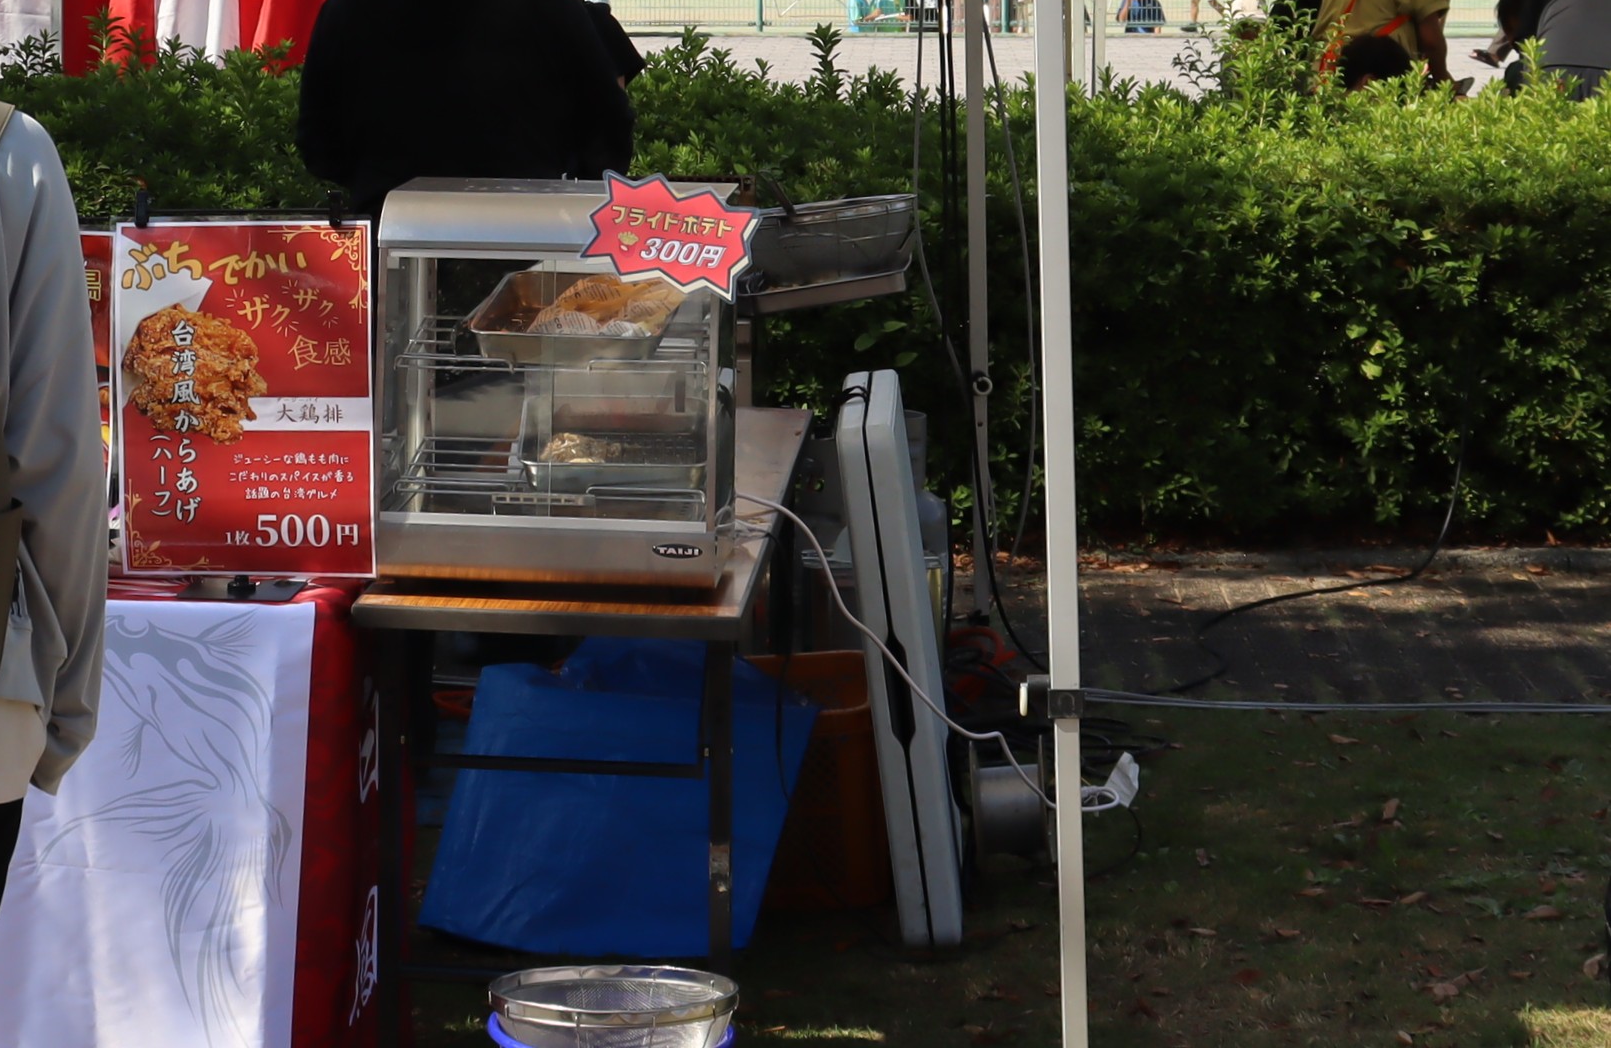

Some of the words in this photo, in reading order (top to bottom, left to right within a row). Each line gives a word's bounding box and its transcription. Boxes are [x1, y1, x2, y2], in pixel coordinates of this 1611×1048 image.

[640, 237, 727, 268] 300円
[288, 334, 351, 370] 食感
[170, 319, 202, 525] 台湾風からあげ
[276, 403, 344, 424] 大鶏排
[233, 453, 350, 466] ジューシーな鶏もも肉に
[229, 470, 355, 483] こだわりのスパイスが香る
[245, 486, 339, 500] 話題の台湾グルメ
[657, 546, 700, 556] TAIJI
